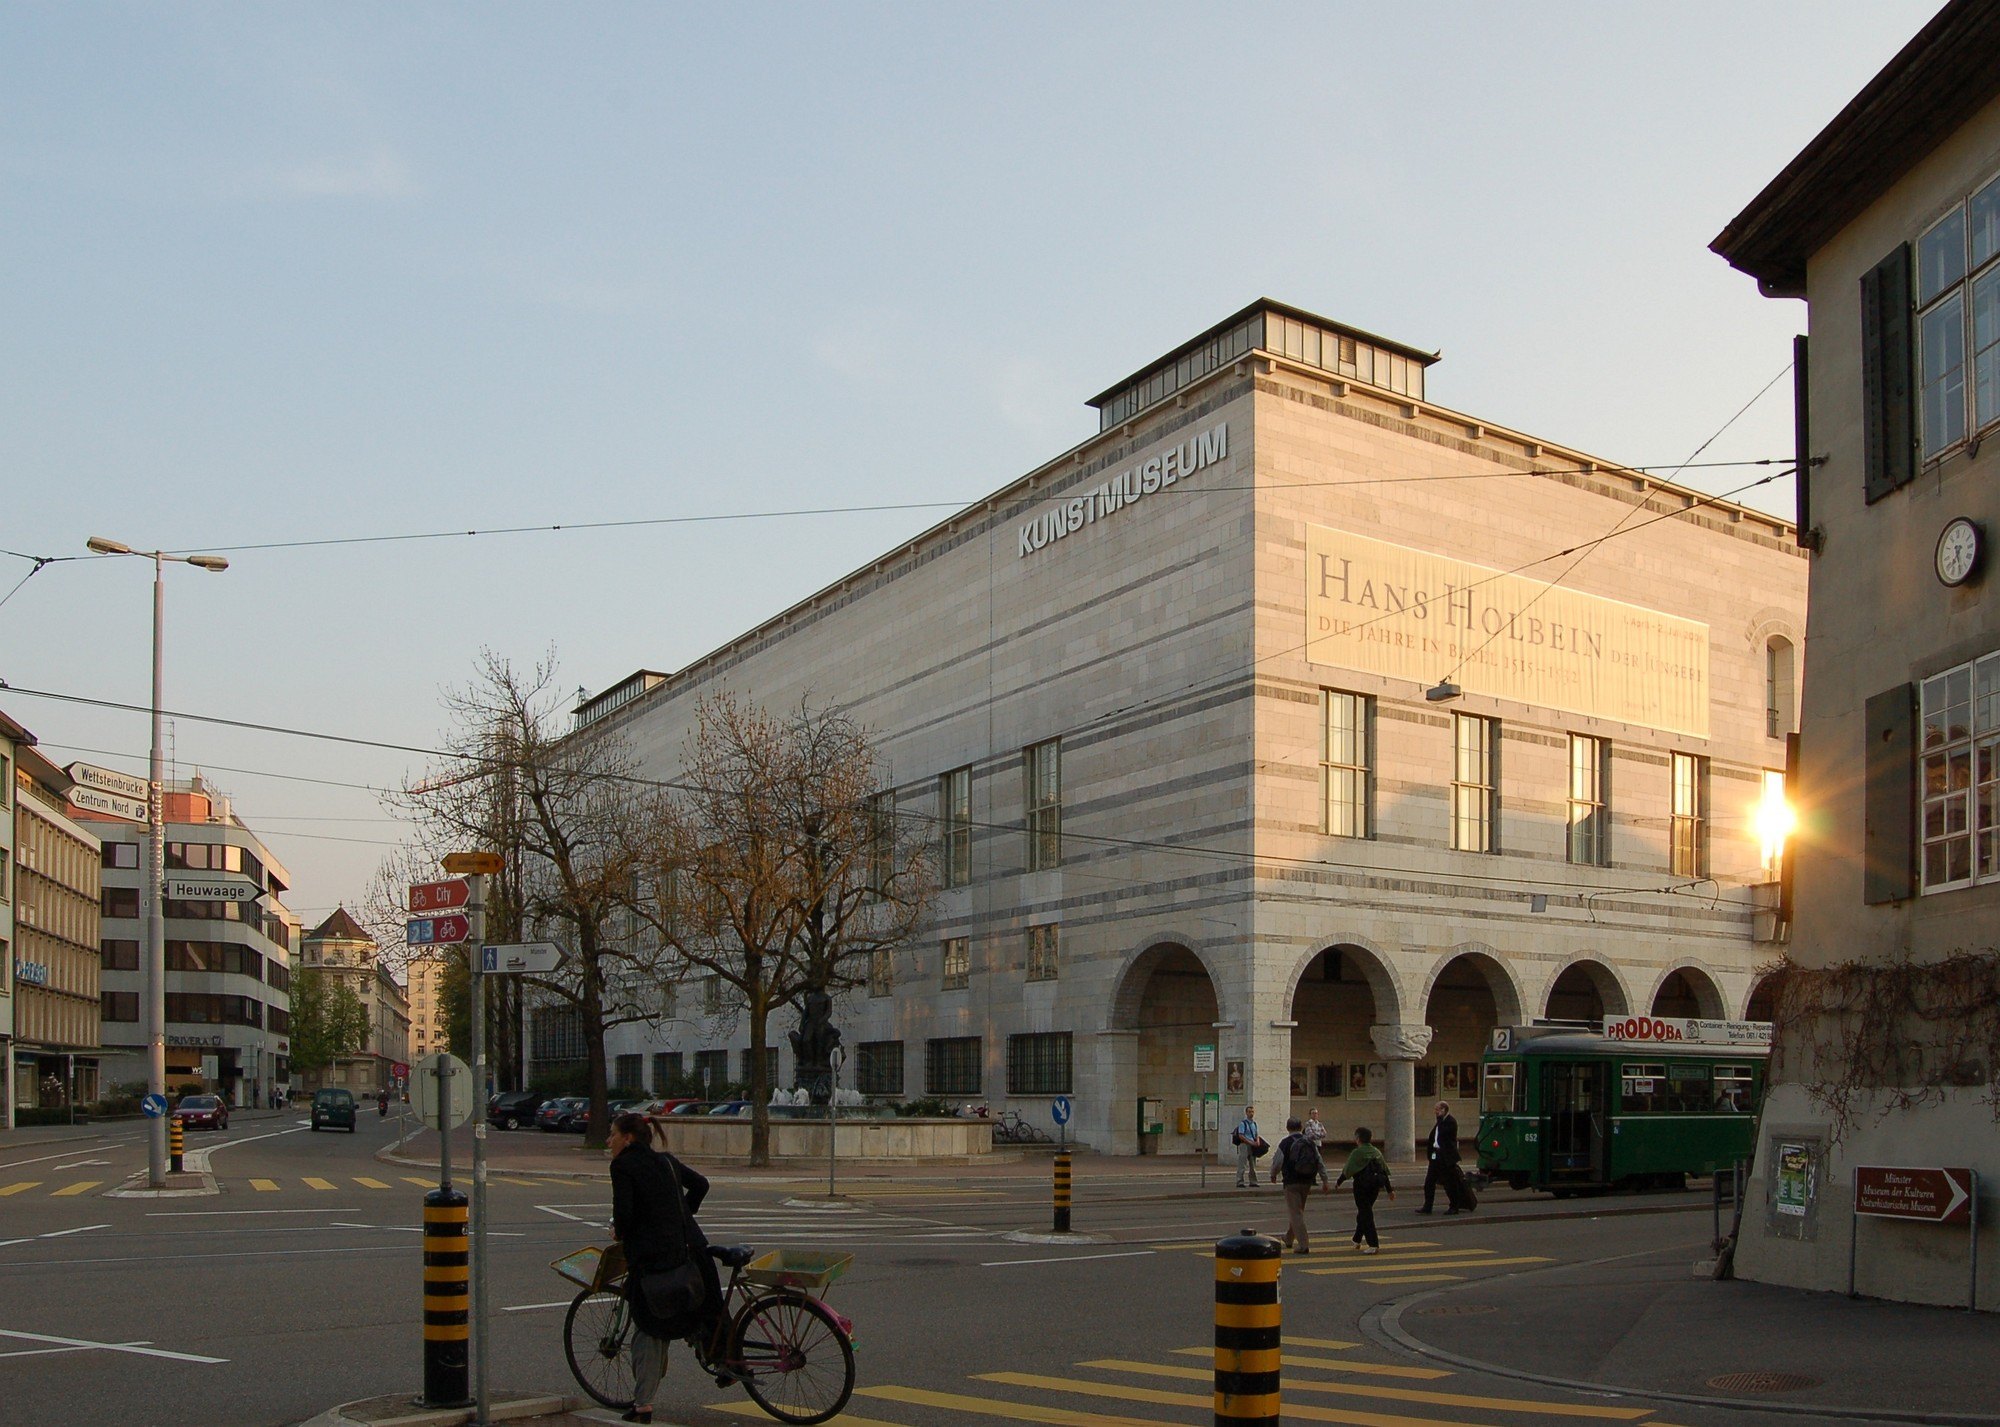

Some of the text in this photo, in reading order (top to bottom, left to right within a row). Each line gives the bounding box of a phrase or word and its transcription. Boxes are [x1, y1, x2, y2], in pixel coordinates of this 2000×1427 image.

[1018, 422, 1228, 558] KUNSTMUSEUM
[1317, 553, 1428, 620] HANS
[1444, 583, 1602, 660] HOLBEIN
[1319, 616, 1351, 636] DIE
[1358, 624, 1415, 649] JAHRE
[1422, 637, 1440, 654] IN
[1449, 643, 1498, 667] BASEL
[81, 767, 144, 795] Wettsteinbrücke
[75, 790, 129, 814] Zentrum Nord
[176, 883, 245, 899] Heuwaage
[436, 886, 451, 905] City
[1608, 1017, 1683, 1041] PRODOBA
[1699, 1021, 1723, 1030] Container
[168, 1035, 209, 1046] PRIVERA
[1497, 1031, 1508, 1049] 2
[1624, 1081, 1630, 1095] 2
[1524, 1133, 1538, 1142] 652
[1884, 1172, 1912, 1185] Münster
[1862, 1184, 1935, 1199] Museum der Kulturen
[1860, 1196, 1936, 1212] Naturhistorisches Museum
